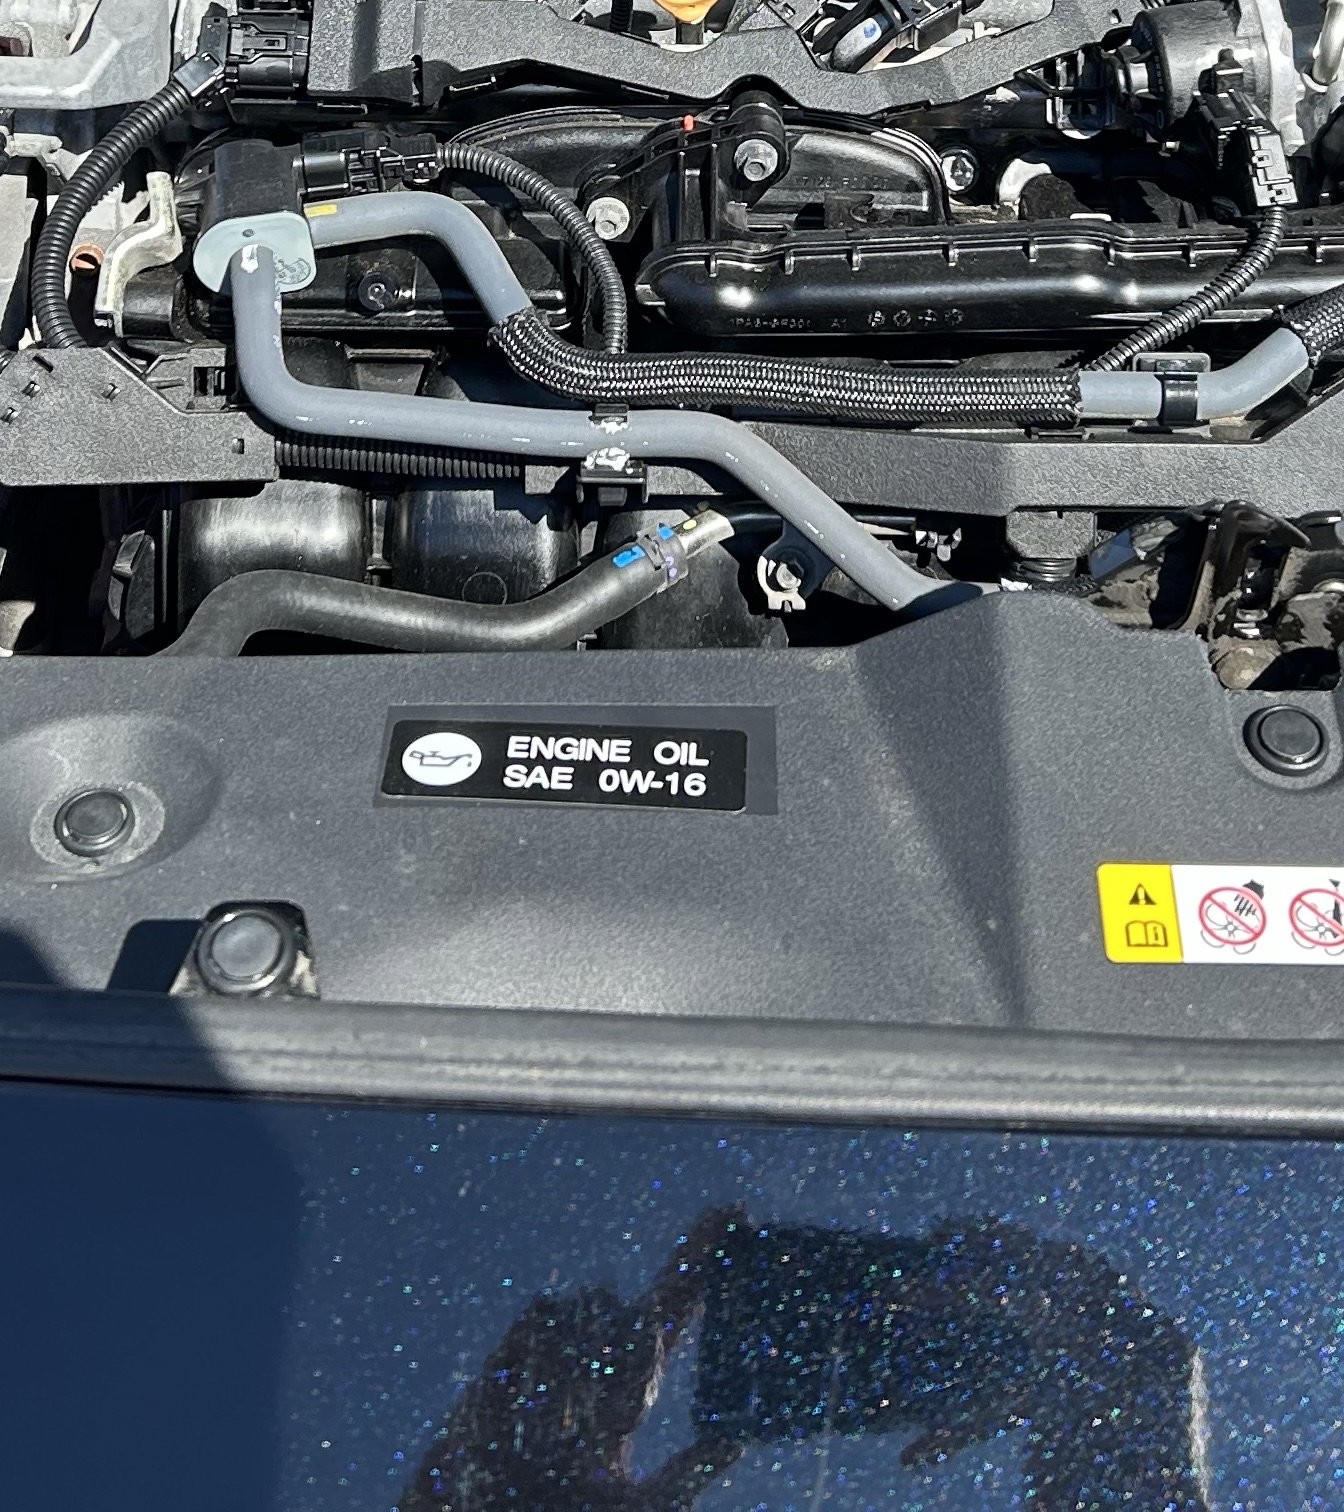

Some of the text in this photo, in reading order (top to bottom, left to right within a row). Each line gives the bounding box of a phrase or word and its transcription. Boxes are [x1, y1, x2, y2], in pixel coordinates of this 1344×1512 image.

[506, 734, 710, 767] ENGINE OIL
[503, 764, 708, 797] SAE 0W-16
